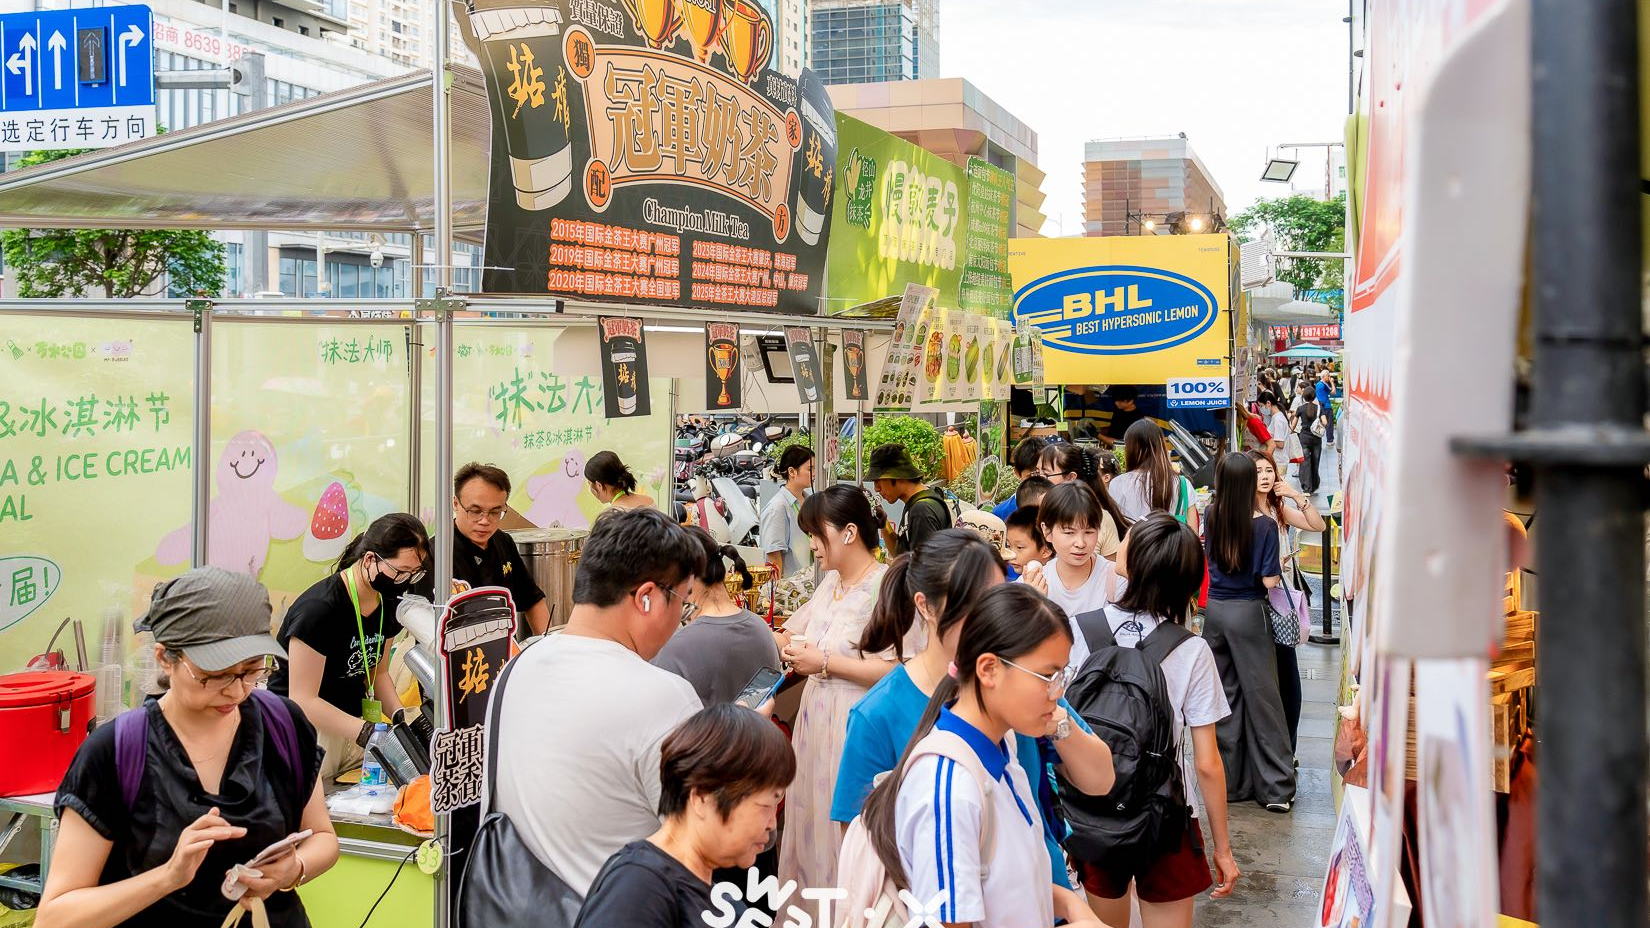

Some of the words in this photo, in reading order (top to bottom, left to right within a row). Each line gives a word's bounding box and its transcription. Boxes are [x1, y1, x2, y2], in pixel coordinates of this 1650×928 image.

[184, 31, 221, 55] 8639
[1, 114, 146, 144] 选定行车方向
[605, 61, 779, 202] 冠軍奶茶
[788, 118, 798, 141] 家
[590, 169, 606, 198] 配
[643, 198, 703, 233] Champion
[704, 210, 730, 236] Milk
[730, 215, 750, 240] Tea
[774, 210, 786, 233] 方
[551, 219, 681, 256] 2015年国际金茶王大赛广州冠军
[550, 245, 680, 278] 2019年国际金茶王大赛广州冠军
[548, 269, 680, 300] 2020年国际金茶王大赛全国亚军
[1063, 284, 1153, 320] BHL
[1076, 320, 1100, 336] BEST
[1101, 310, 1162, 331] HYPERSONIC
[1164, 304, 1199, 323] LEMON
[1170, 382, 1225, 395] 100%
[1206, 399, 1228, 407] JUICE
[523, 425, 594, 449] 抹茶&冰淇淋节
[27, 455, 48, 486] &
[56, 452, 98, 482] ICE
[105, 446, 192, 477] CREAM
[419, 843, 440, 867] 33
